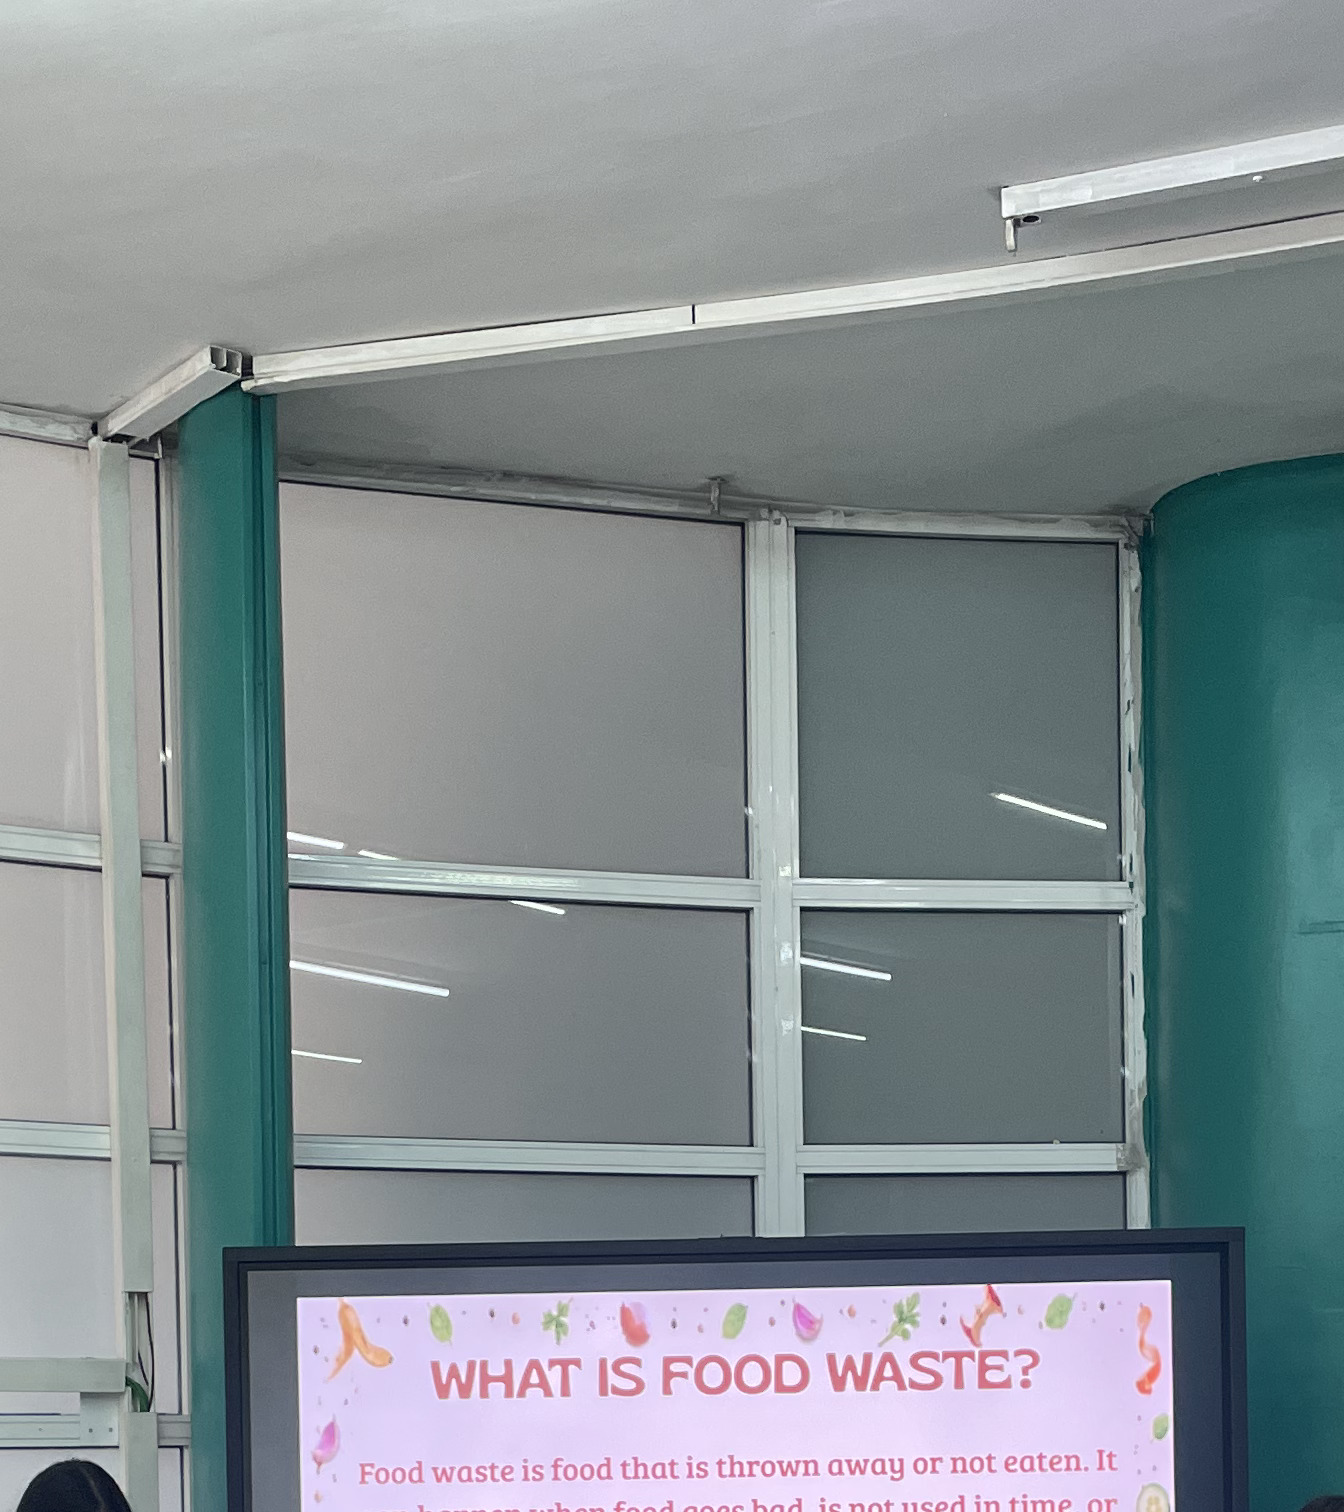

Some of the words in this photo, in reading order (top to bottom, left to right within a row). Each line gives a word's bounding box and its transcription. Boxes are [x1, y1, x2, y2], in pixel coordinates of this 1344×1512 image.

[430, 1358, 583, 1400] WHAT
[598, 1356, 646, 1397] IS
[661, 1352, 811, 1396] FOOD
[826, 1348, 1042, 1393] WASTE?
[359, 1460, 425, 1485] Food
[431, 1462, 515, 1484] waste
[521, 1458, 545, 1482] is
[550, 1456, 614, 1482] food
[619, 1456, 680, 1481] that
[685, 1455, 709, 1479] is
[715, 1454, 821, 1479] thrown
[827, 1457, 905, 1482] away
[912, 1456, 944, 1475] or
[949, 1453, 998, 1474] not
[1003, 1451, 1089, 1473] eaten.
[1096, 1449, 1119, 1472] It
